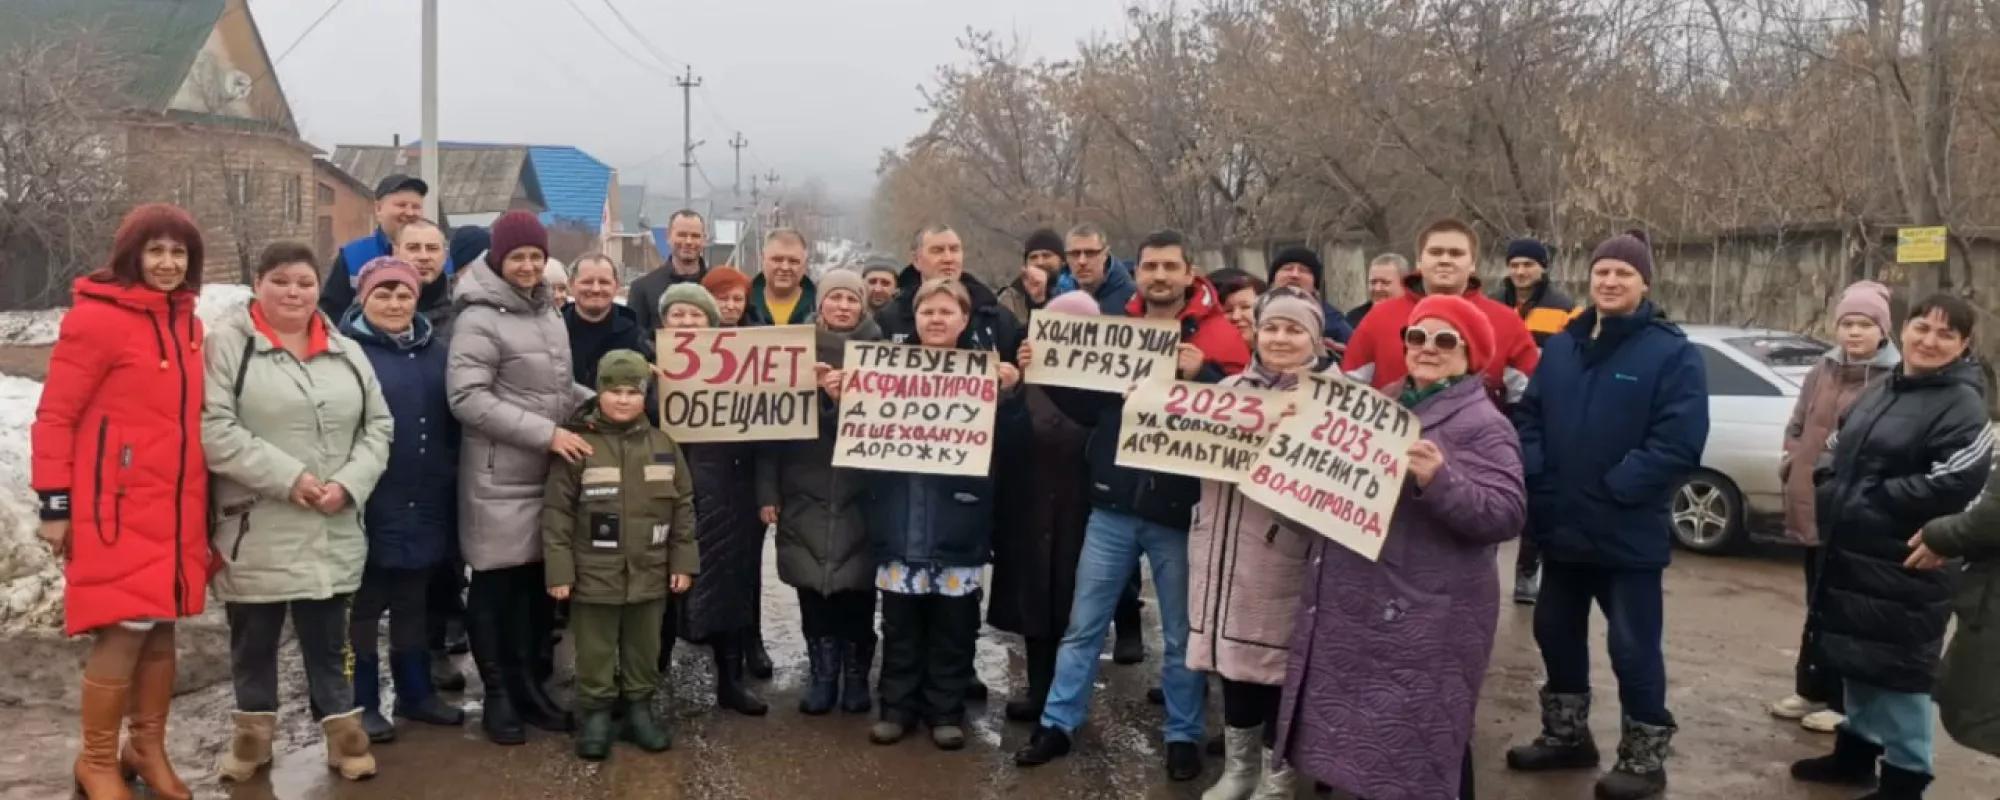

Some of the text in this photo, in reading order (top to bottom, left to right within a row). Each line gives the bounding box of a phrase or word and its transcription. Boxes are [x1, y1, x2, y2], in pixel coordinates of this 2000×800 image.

[1035, 320, 1179, 357] ХОДИМ ПО УШИ
[855, 345, 987, 375] ТРЕБУЕМ
[1043, 348, 1153, 381] В ГРЯЗИ
[845, 370, 995, 402] АСФАЛЬТИРОВ
[665, 390, 815, 433] ОБЕЩАЮТ
[845, 400, 980, 423] ДОРОГУ
[1164, 384, 1264, 433] 2023
[1309, 376, 1410, 437] ТРЕБУЕМ
[840, 422, 987, 446] ПЕШЕХОДНУЮ
[1311, 410, 1373, 462] 2023
[847, 441, 968, 465] ДОРОЖКУ
[1269, 434, 1380, 498] ЗАМЕНИТЬ
[1251, 464, 1382, 537] ВОДОПРОВОД
